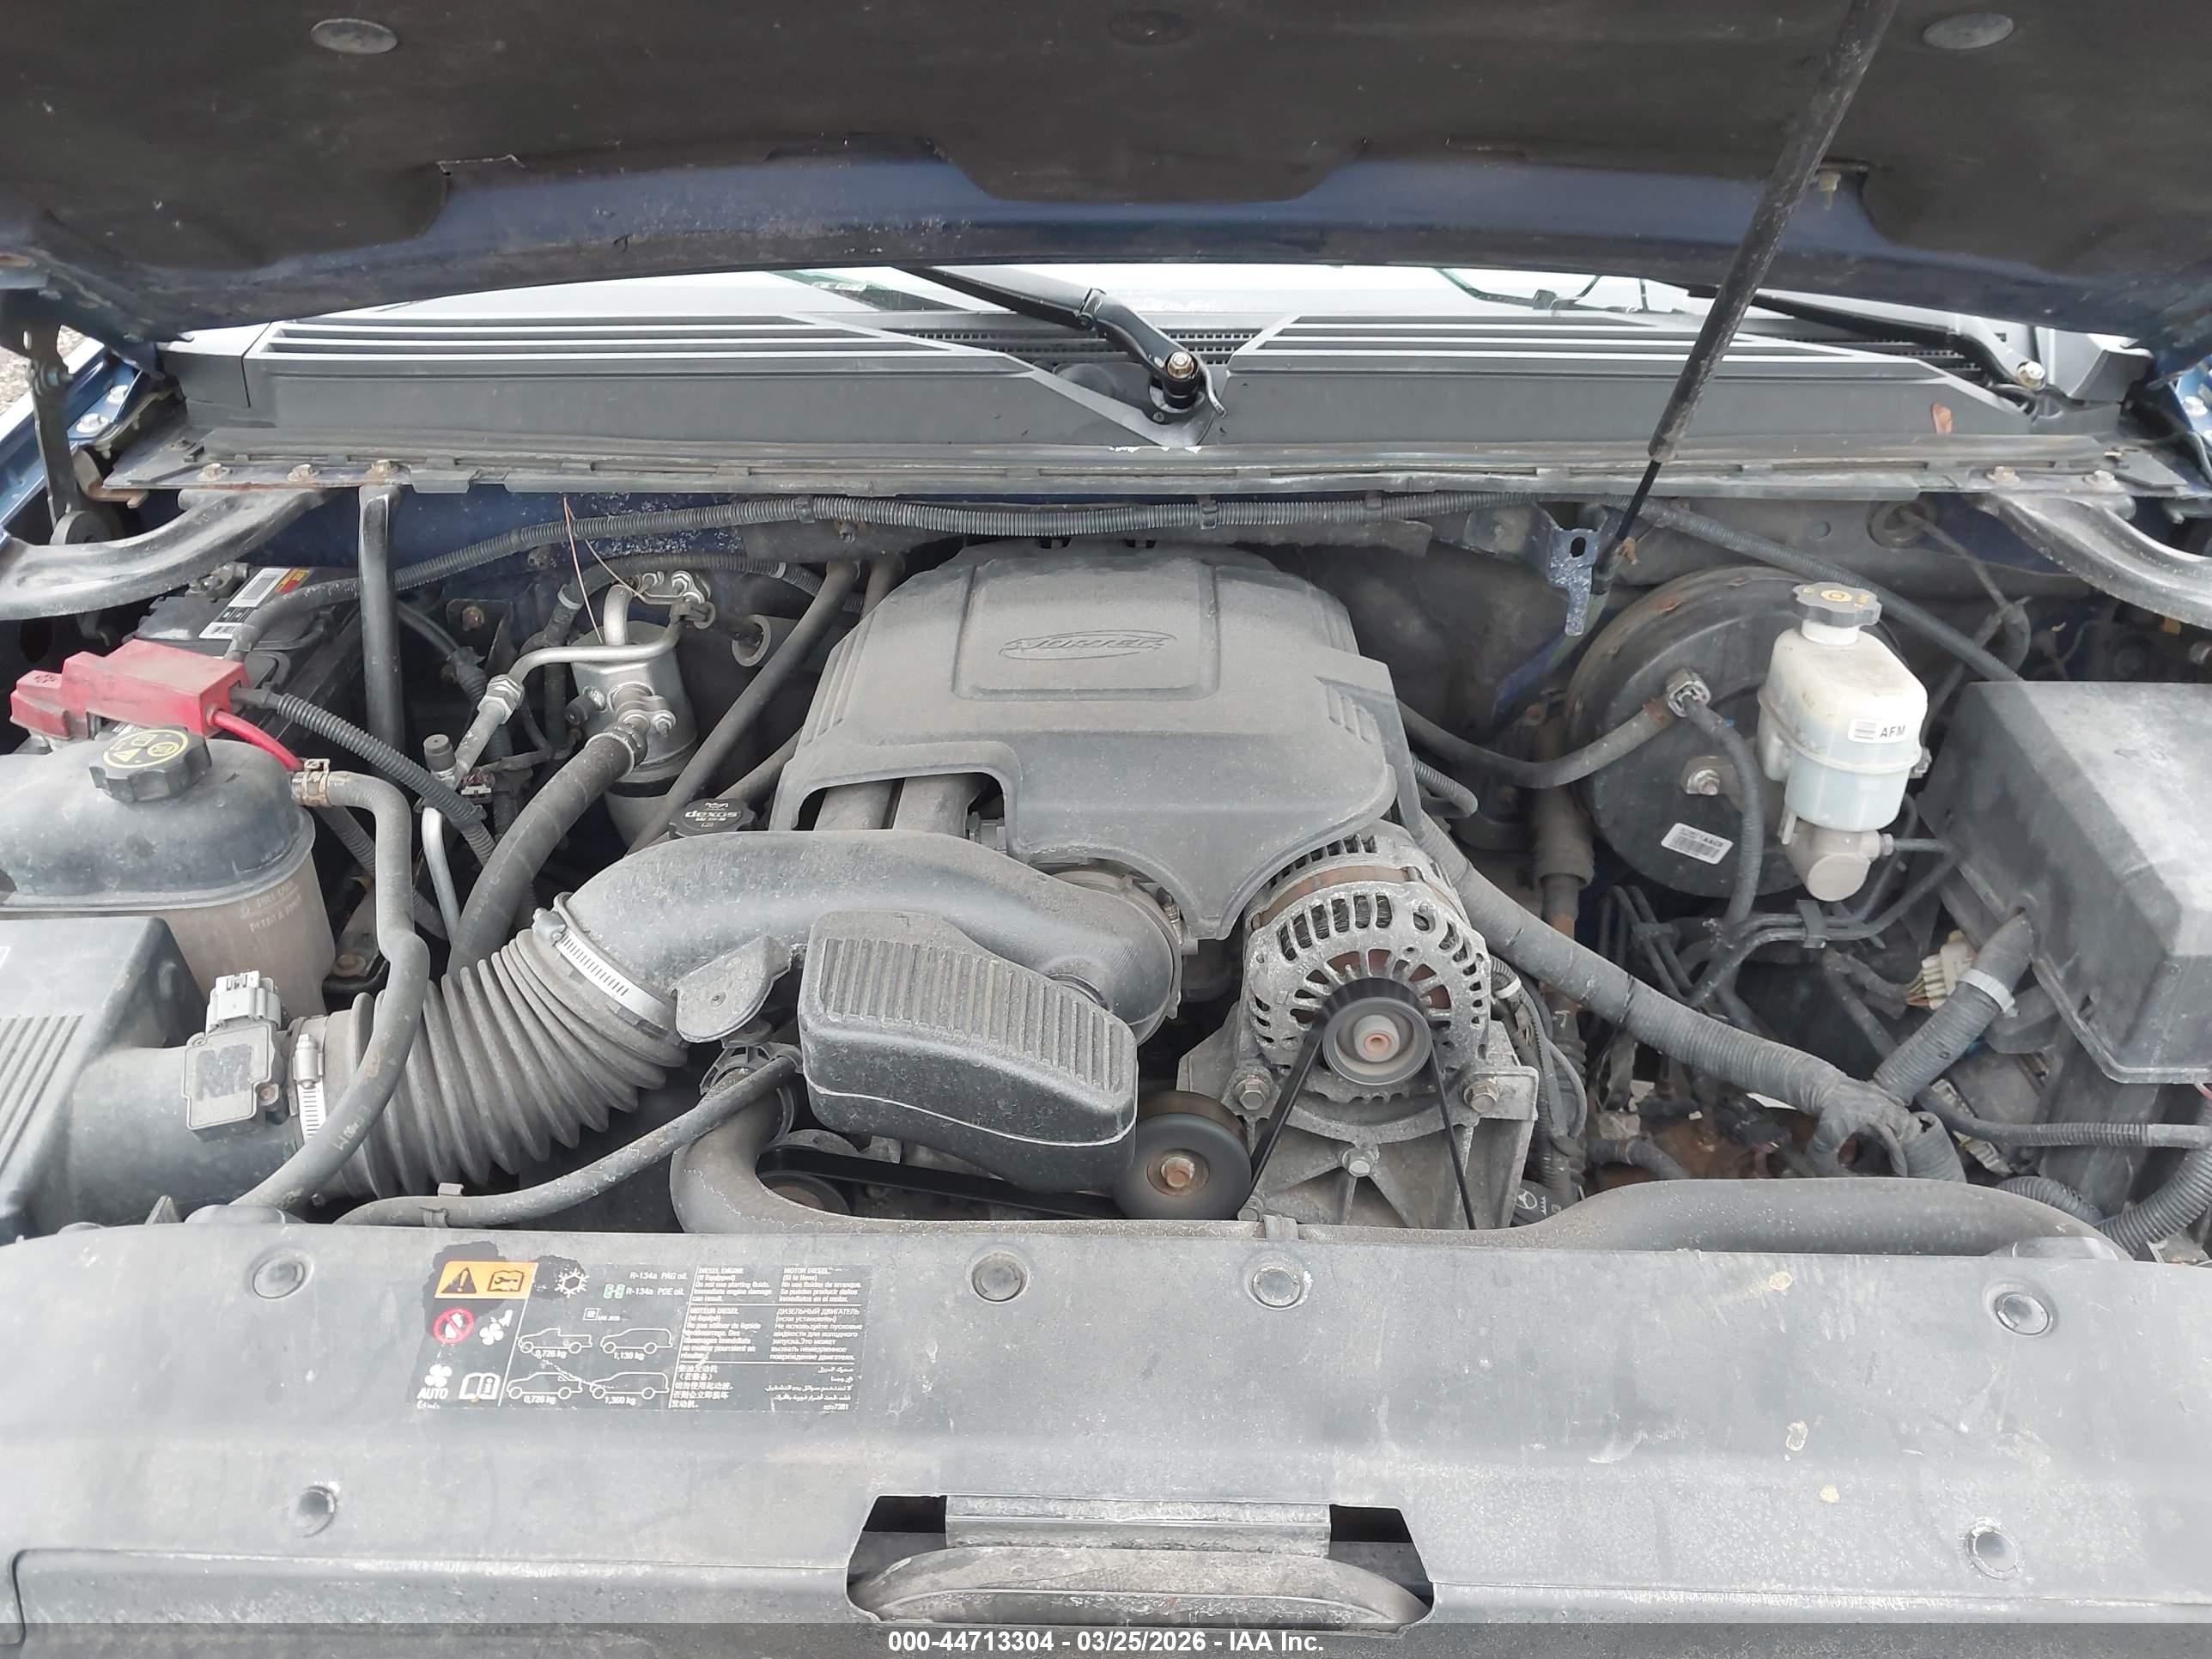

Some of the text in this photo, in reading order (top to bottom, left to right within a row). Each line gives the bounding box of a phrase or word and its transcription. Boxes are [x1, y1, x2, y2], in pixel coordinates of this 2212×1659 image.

[1880, 725, 1906, 738] AFM
[635, 1352, 646, 1361] kg
[416, 1387, 449, 1400] AUTO
[545, 1395, 556, 1404] kg
[625, 1397, 636, 1406] kg
